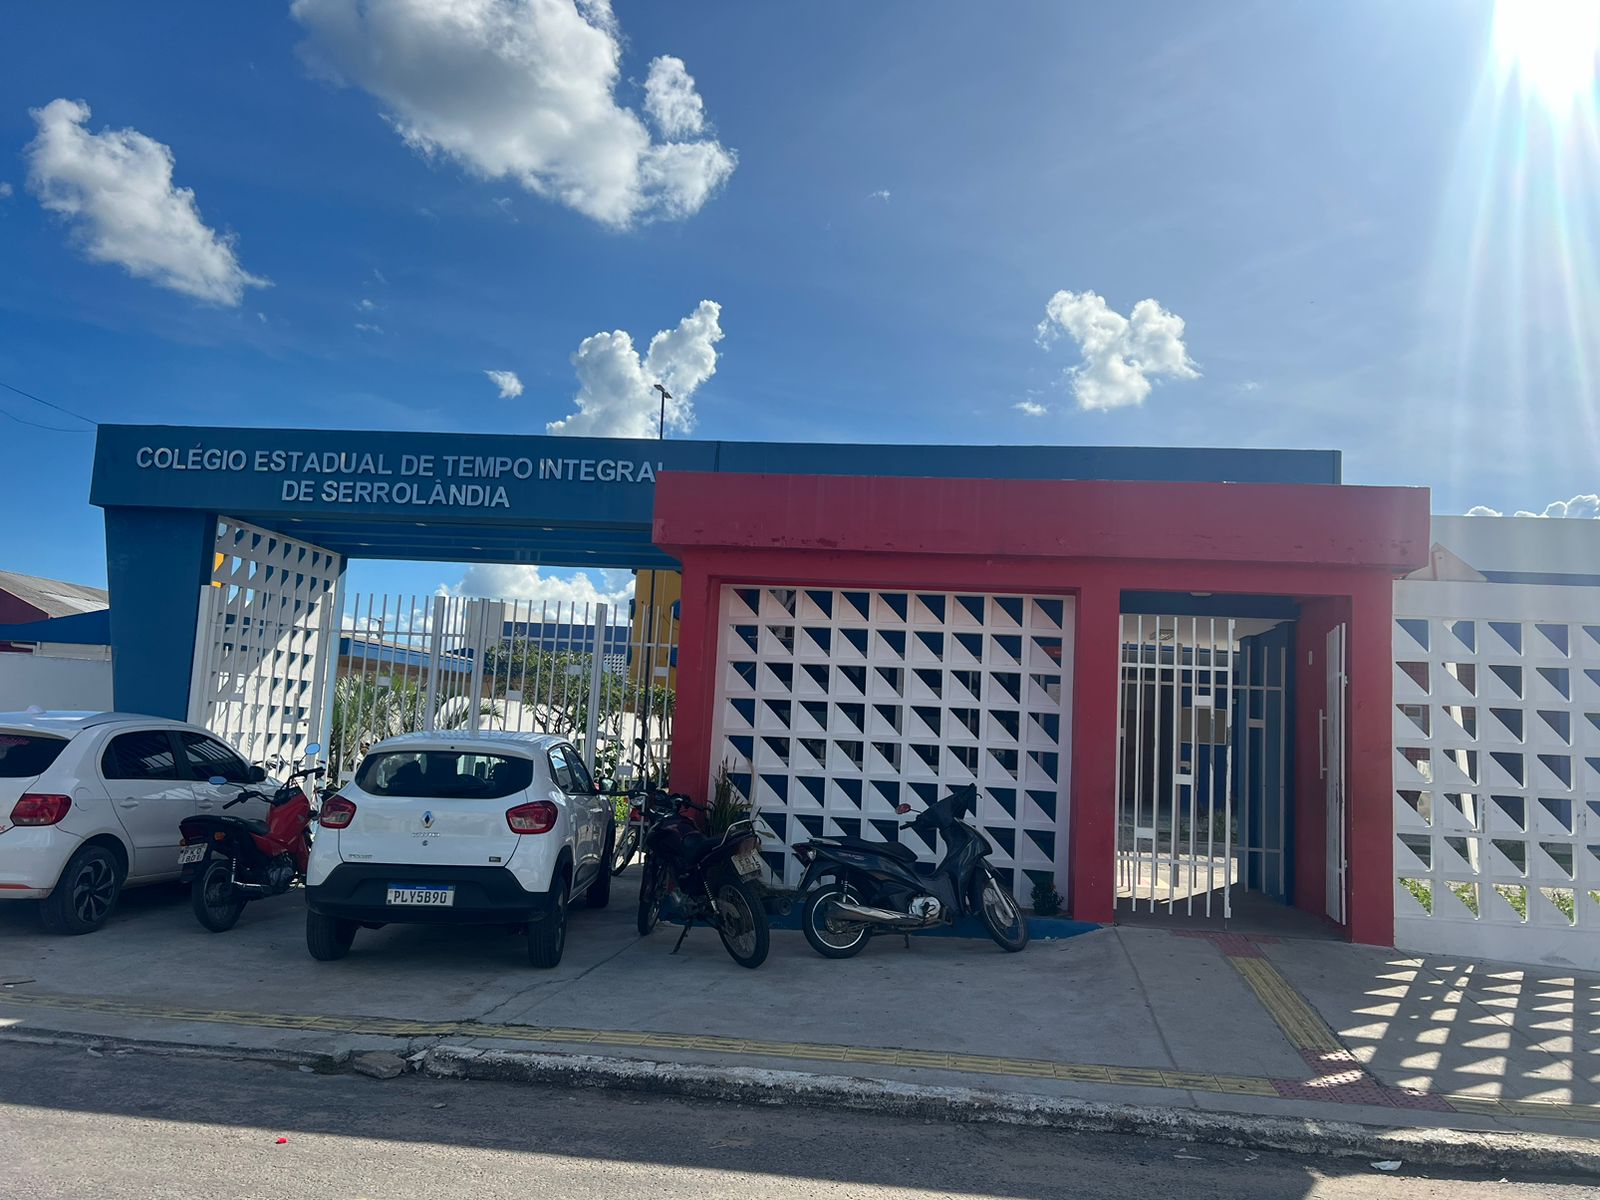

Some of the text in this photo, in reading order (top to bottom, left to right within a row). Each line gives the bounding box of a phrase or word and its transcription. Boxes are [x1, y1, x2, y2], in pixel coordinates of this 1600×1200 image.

[136, 442, 247, 472] COLÉGIO
[253, 450, 393, 475] ESTADUAL
[401, 454, 435, 477] DE
[443, 455, 533, 480] TEMPO
[281, 479, 511, 508] DE SERROLÂNDIA
[393, 890, 447, 904] PLY5B90
